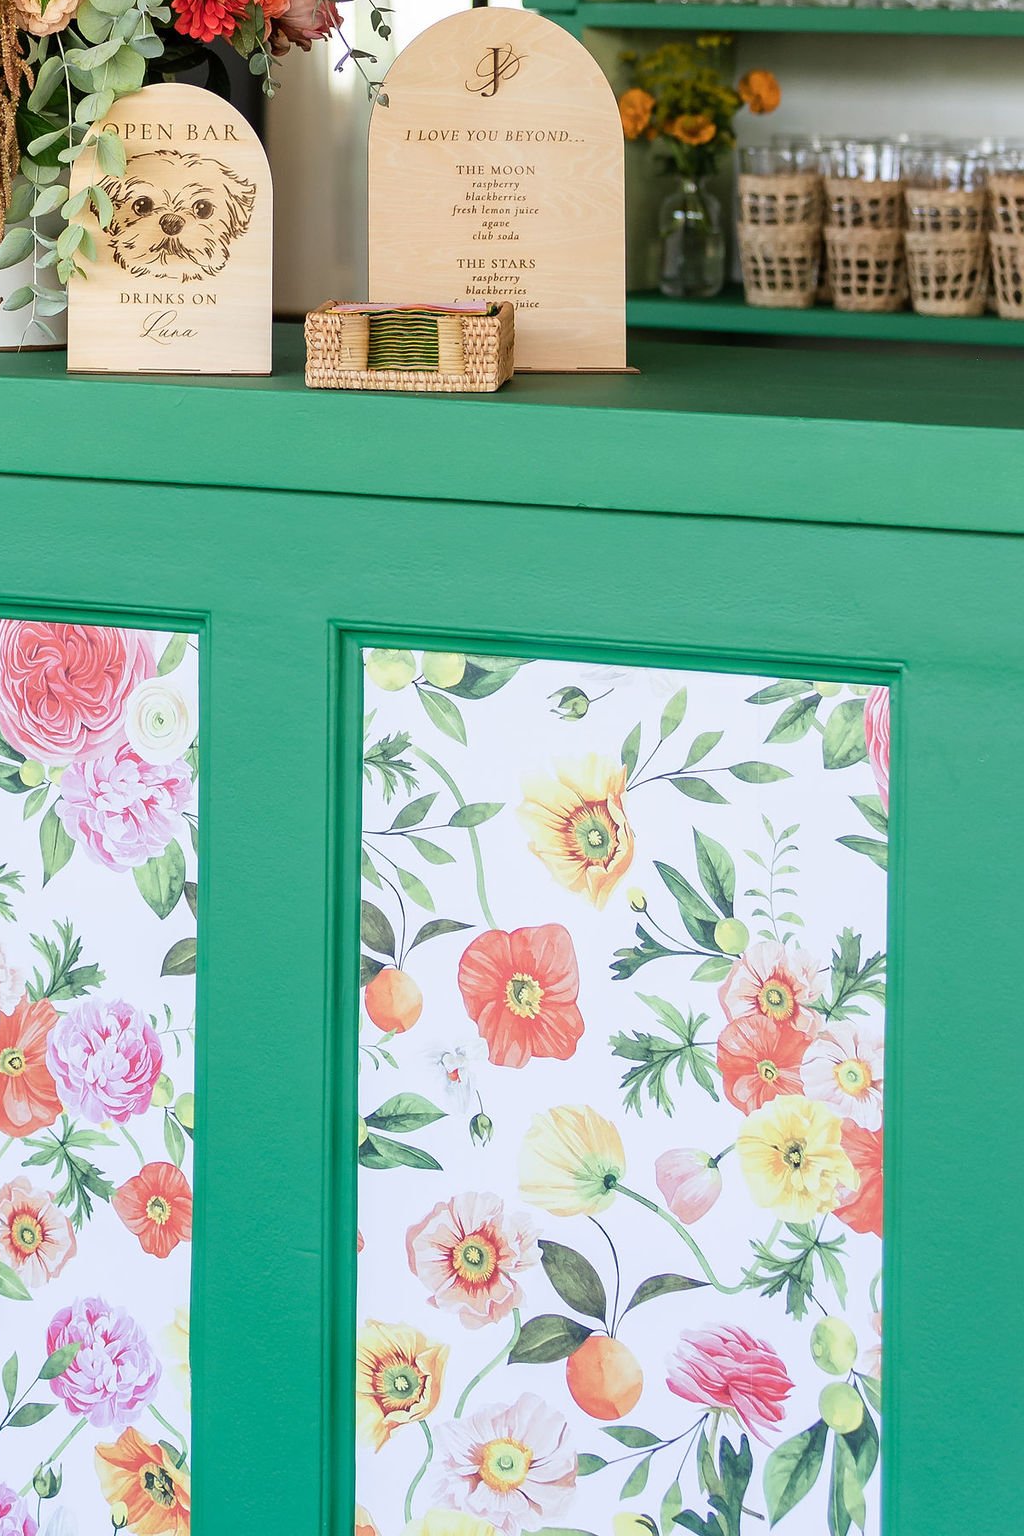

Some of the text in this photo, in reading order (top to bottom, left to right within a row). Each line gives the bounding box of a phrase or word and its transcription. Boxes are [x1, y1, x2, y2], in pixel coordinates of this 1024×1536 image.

[102, 122, 239, 141] OPEN BAR
[404, 129, 585, 142] I LOVE YOU BEYOND...
[456, 165, 535, 175] THE MOON
[472, 179, 520, 191] raspberry
[465, 192, 527, 201] blackberries
[451, 205, 539, 216] fresh lemon juice
[482, 221, 510, 230] agave
[472, 231, 520, 240] club soda
[457, 259, 536, 269] THE STARS
[472, 273, 520, 284] raspberry
[465, 286, 527, 295] blackberries
[120, 293, 217, 305] DRINKS ON
[514, 300, 540, 310] juice
[139, 310, 198, 345] Luna
